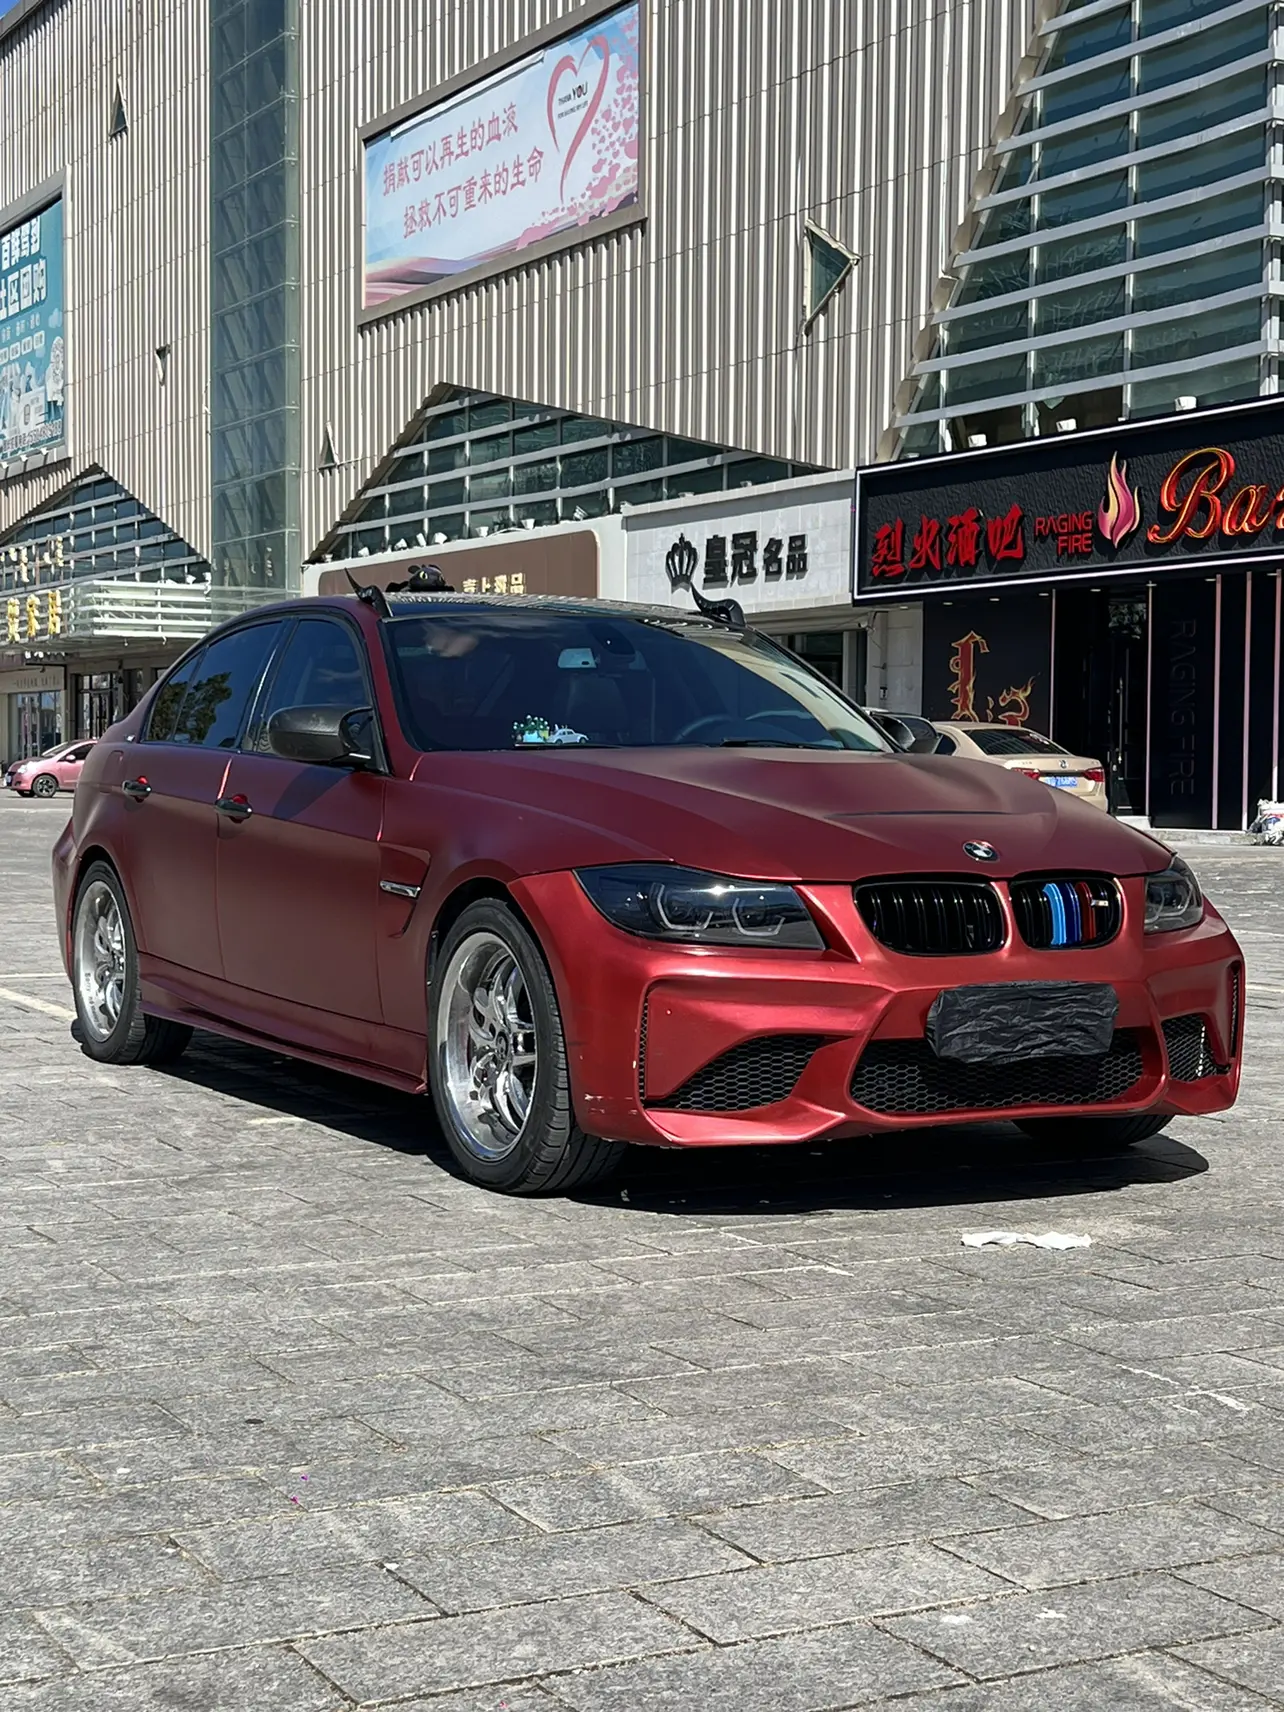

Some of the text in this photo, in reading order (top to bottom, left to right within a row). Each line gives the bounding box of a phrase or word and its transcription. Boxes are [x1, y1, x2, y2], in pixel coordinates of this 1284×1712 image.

[572, 80, 588, 100] YOU
[383, 101, 519, 196] 捐献可以再生的血液
[403, 146, 545, 239] 拯救不可重来的生命
[872, 503, 1024, 577] 烈火酒吧
[1034, 511, 1093, 536] RAGING
[1057, 533, 1092, 556] FIRE
[702, 530, 808, 588] 皇冠名品
[1168, 618, 1197, 796] RAGING FIRE
